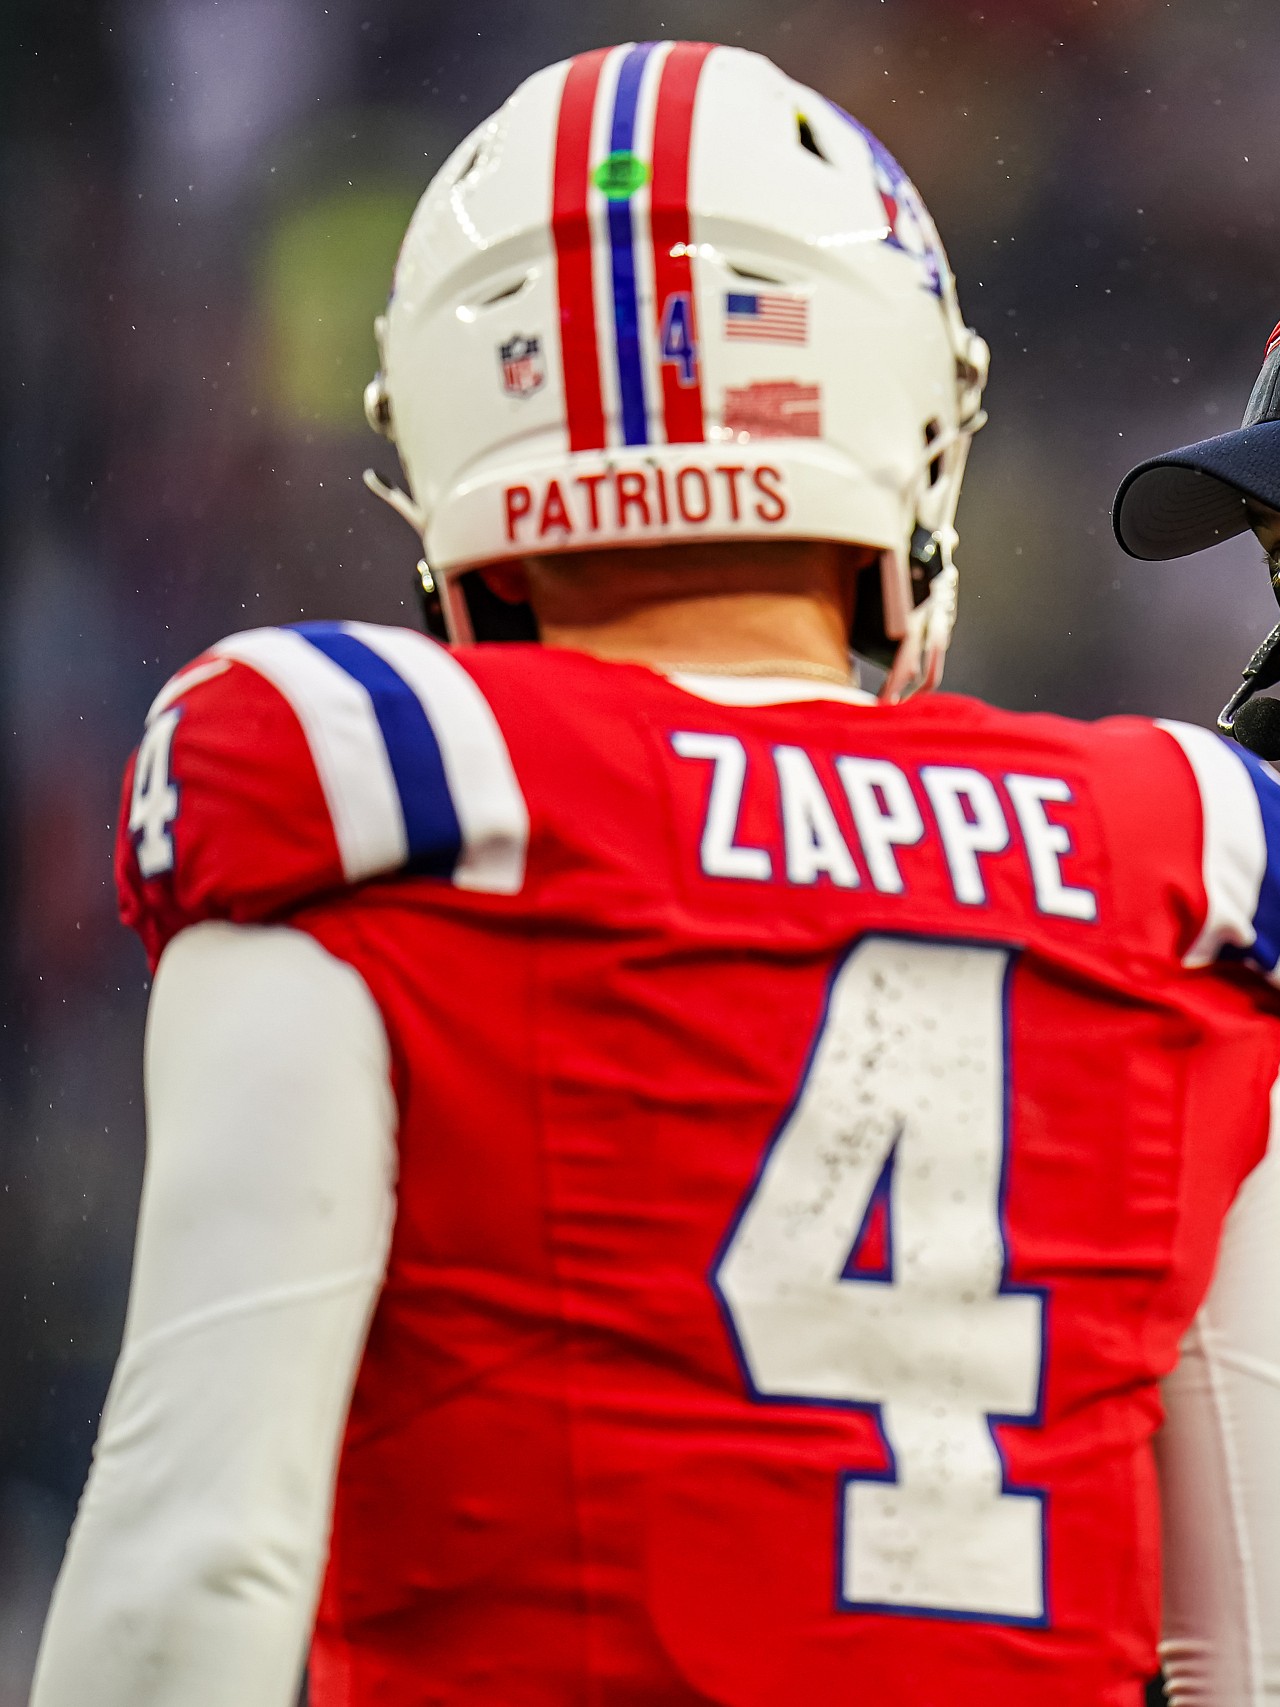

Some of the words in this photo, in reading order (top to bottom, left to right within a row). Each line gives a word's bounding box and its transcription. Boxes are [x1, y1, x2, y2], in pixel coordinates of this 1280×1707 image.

[660, 292, 697, 388] 4
[504, 466, 786, 541] PATRIOTS
[128, 705, 183, 879] 4
[672, 731, 1097, 920] ZAPPE
[712, 932, 1049, 1625] 4
